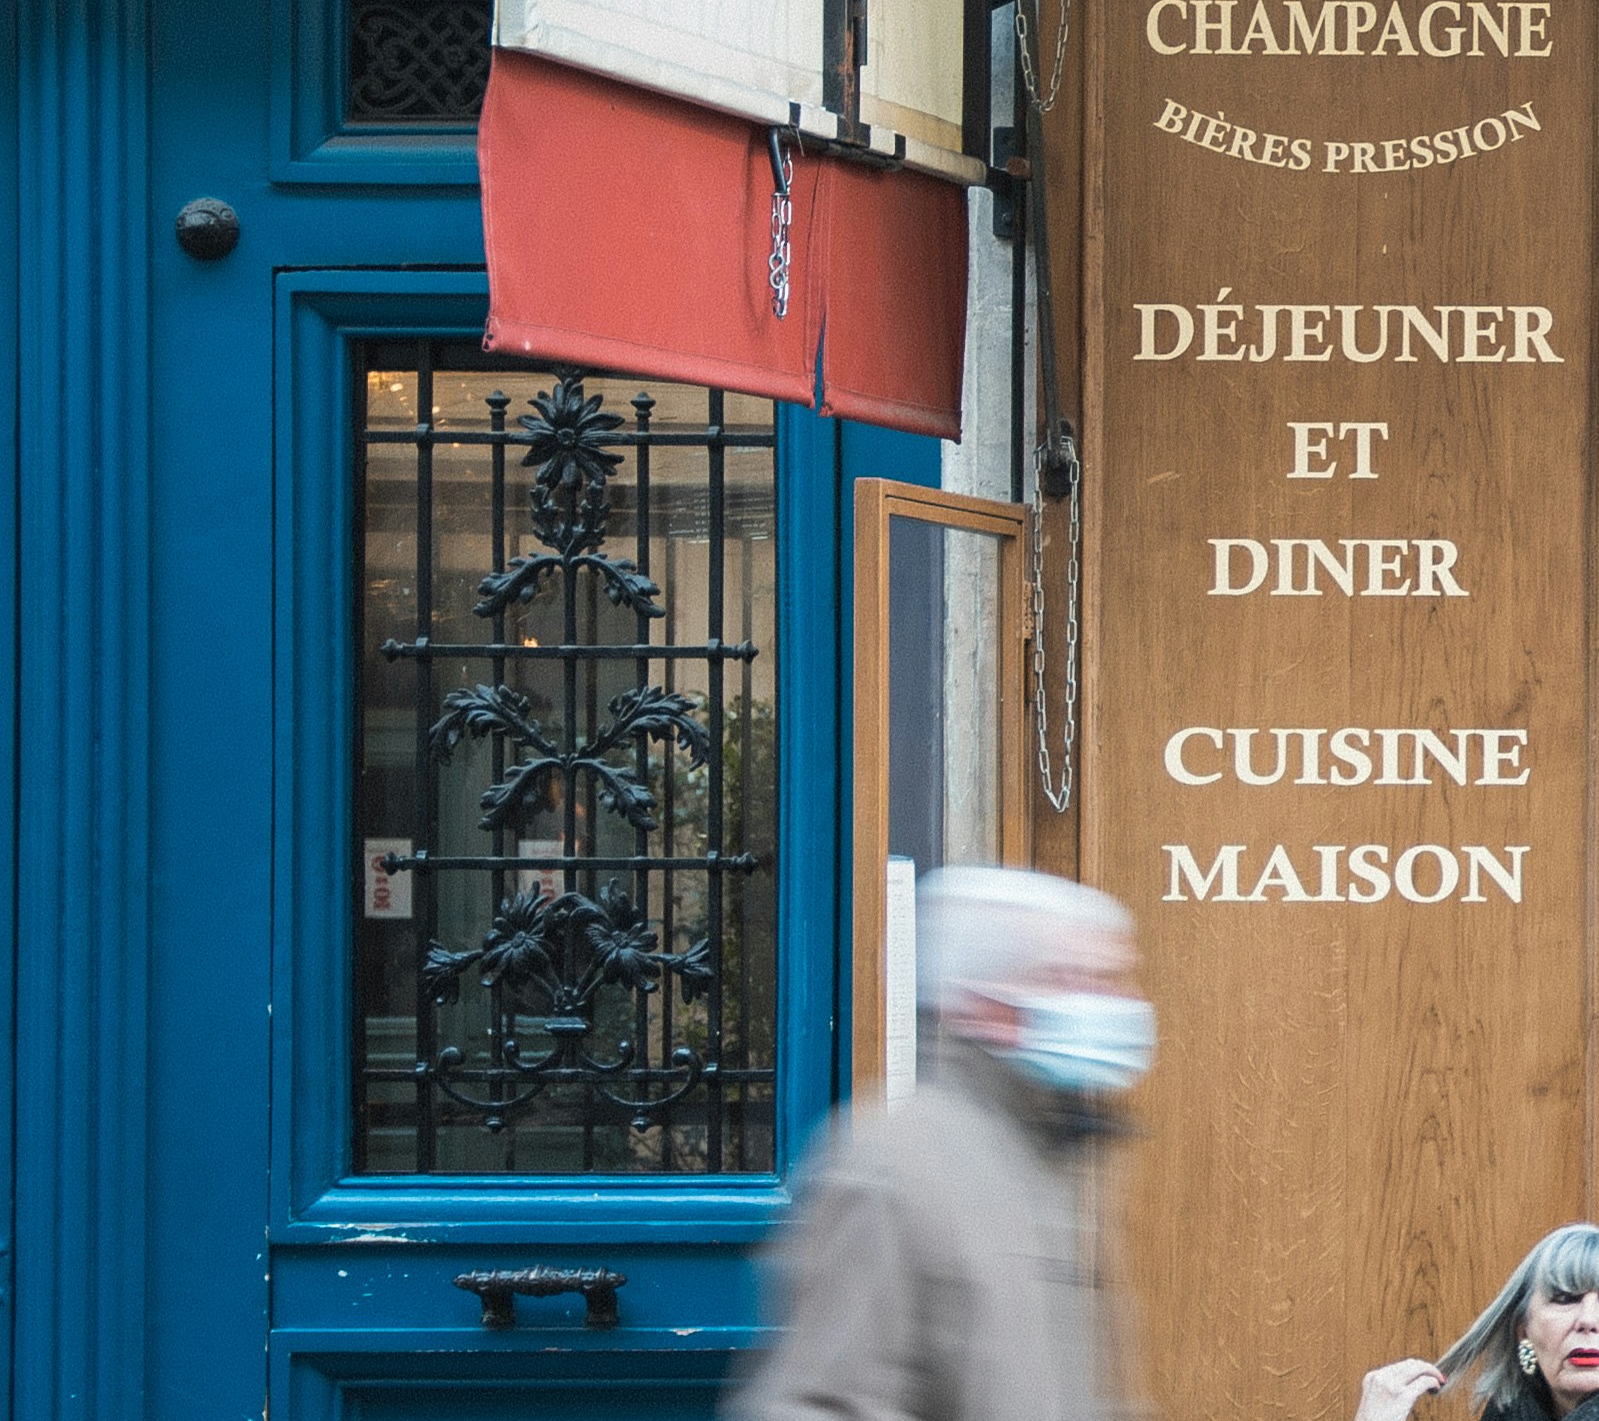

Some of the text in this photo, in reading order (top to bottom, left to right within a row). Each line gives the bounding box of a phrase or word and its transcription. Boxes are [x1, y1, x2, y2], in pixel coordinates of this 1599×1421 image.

[1153, 99, 1542, 174] BIÈRES PRESSION
[1133, 287, 1565, 363] DÉJEUNER
[1286, 422, 1389, 479] ET
[1207, 538, 1470, 597] DINER
[1163, 726, 1531, 787] CUISINE
[1162, 843, 1530, 904] MAISON
